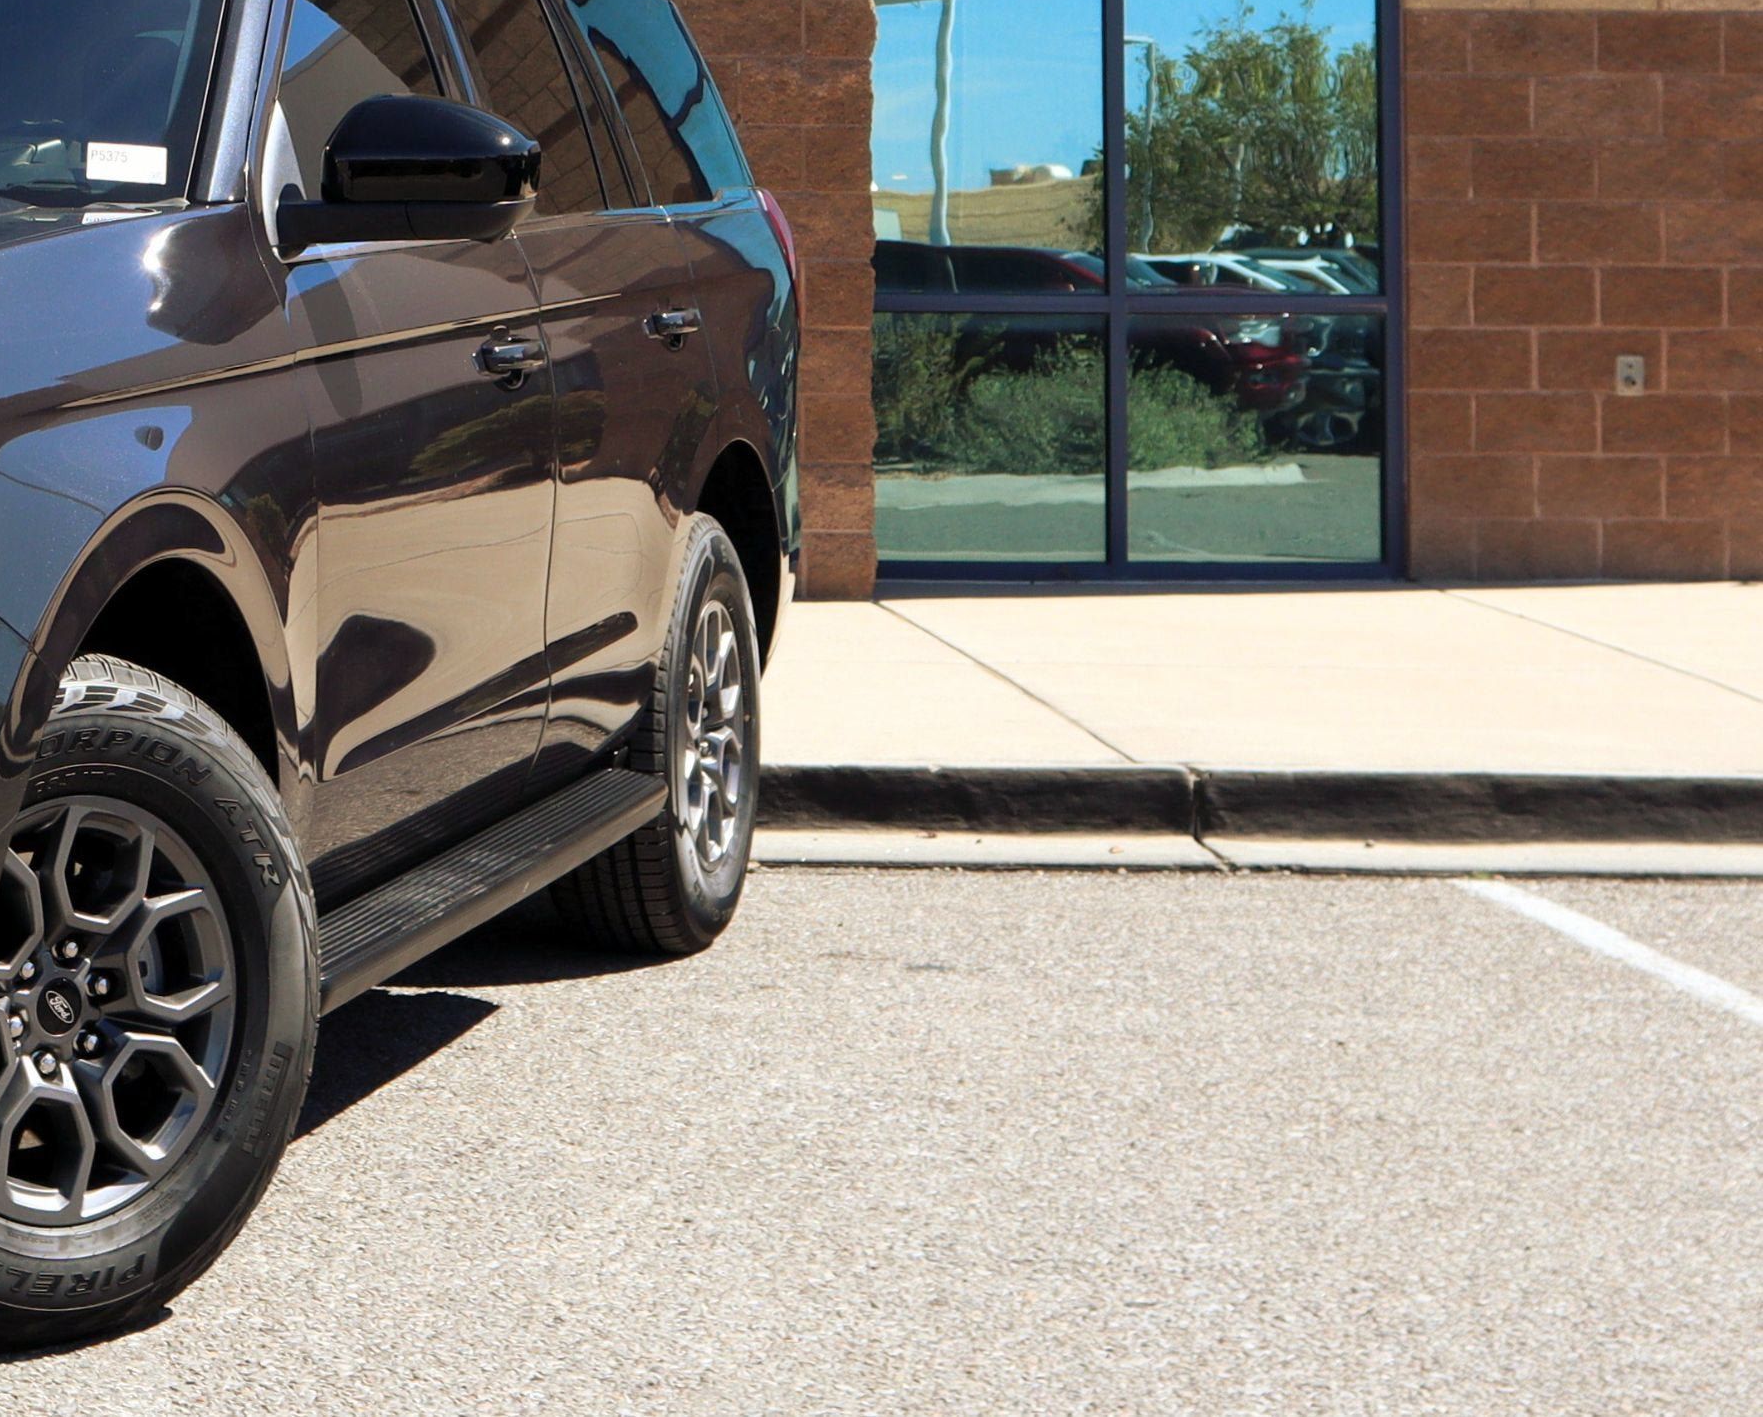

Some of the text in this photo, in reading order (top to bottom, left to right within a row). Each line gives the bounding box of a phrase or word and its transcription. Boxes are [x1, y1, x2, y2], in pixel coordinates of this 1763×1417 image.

[91, 149, 128, 163] P5375
[35, 727, 282, 887] ORPION ATR
[49, 996, 71, 1019] Ford
